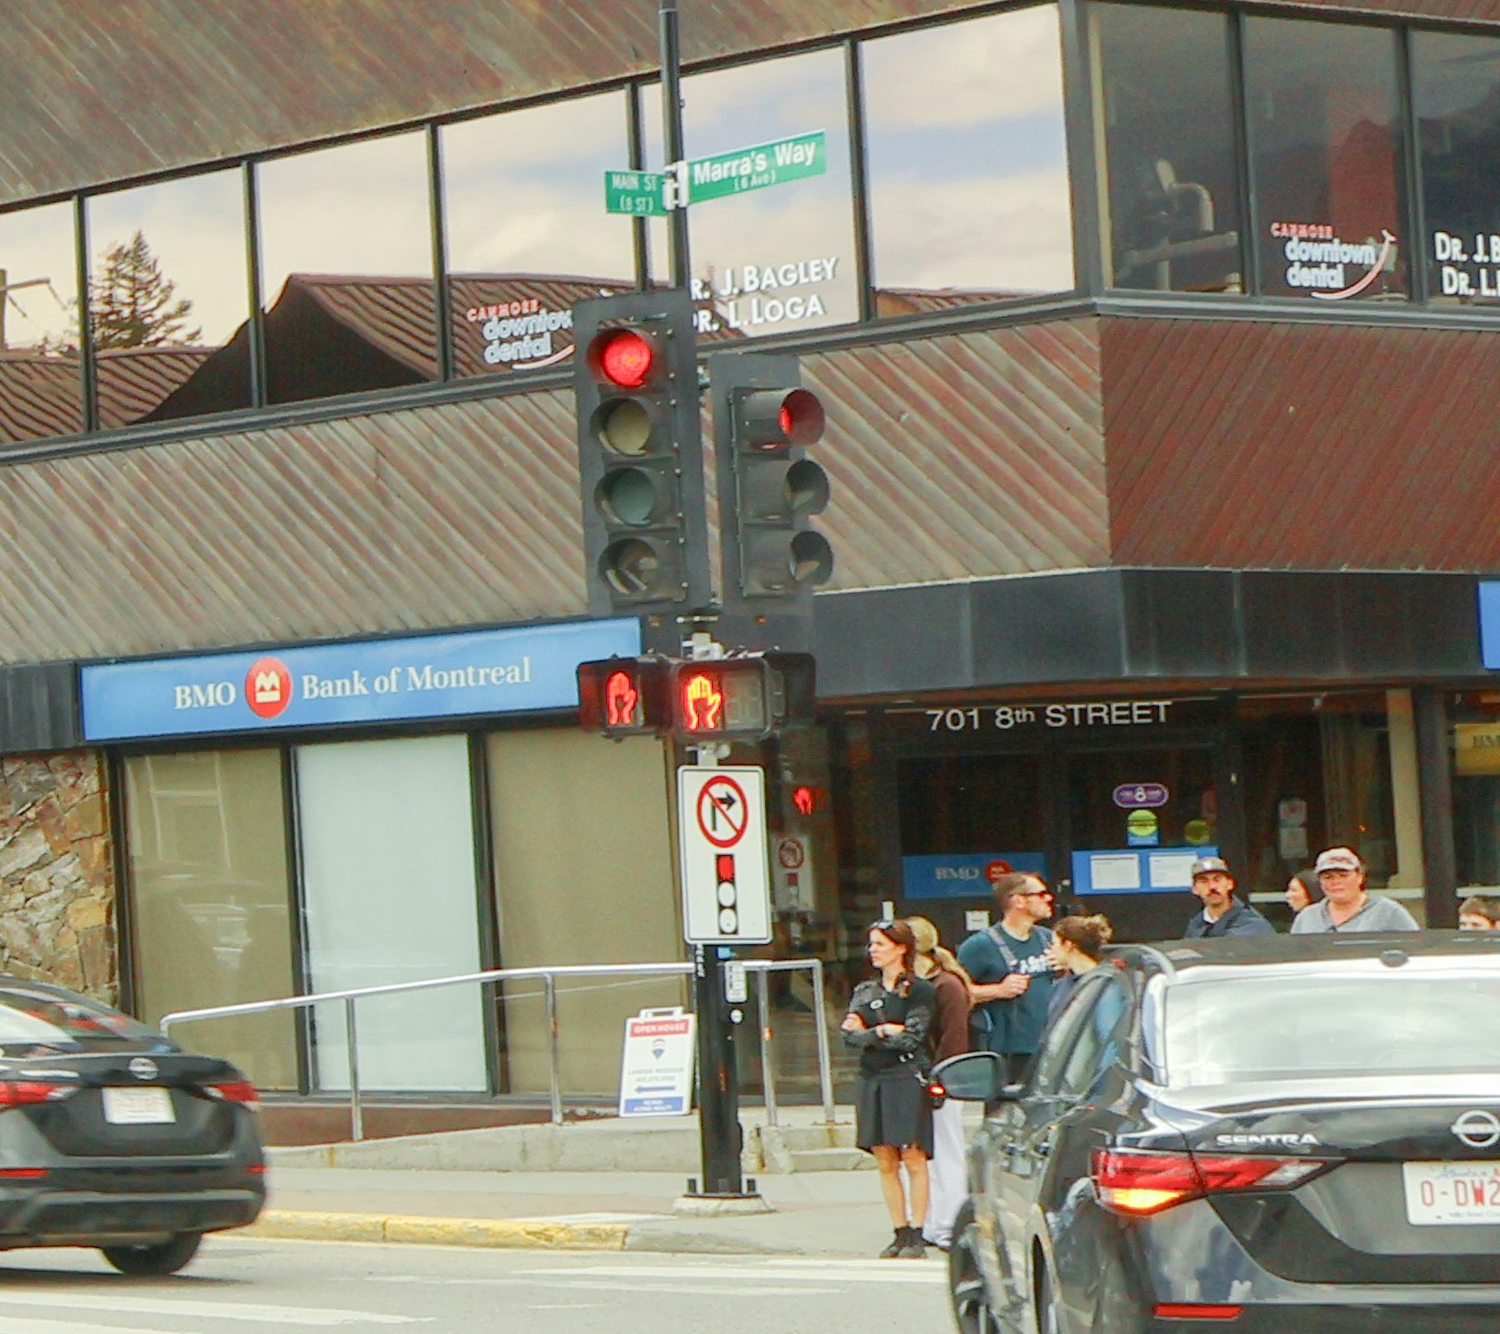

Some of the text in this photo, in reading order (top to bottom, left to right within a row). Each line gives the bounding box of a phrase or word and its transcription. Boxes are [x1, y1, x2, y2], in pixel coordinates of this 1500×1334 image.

[693, 142, 816, 185] Marra's Way
[612, 174, 657, 191] MAIN ST
[1285, 236, 1376, 265] downtown
[1287, 261, 1345, 288] dental
[690, 278, 711, 300] R.
[692, 309, 720, 333] R.
[484, 331, 551, 364] dental
[174, 657, 531, 710] BMO Bank of Montreal
[926, 701, 1172, 731] 701 8th STREET
[633, 1023, 686, 1034] OPEN HOUSE
[1216, 1133, 1321, 1147] SENTRA
